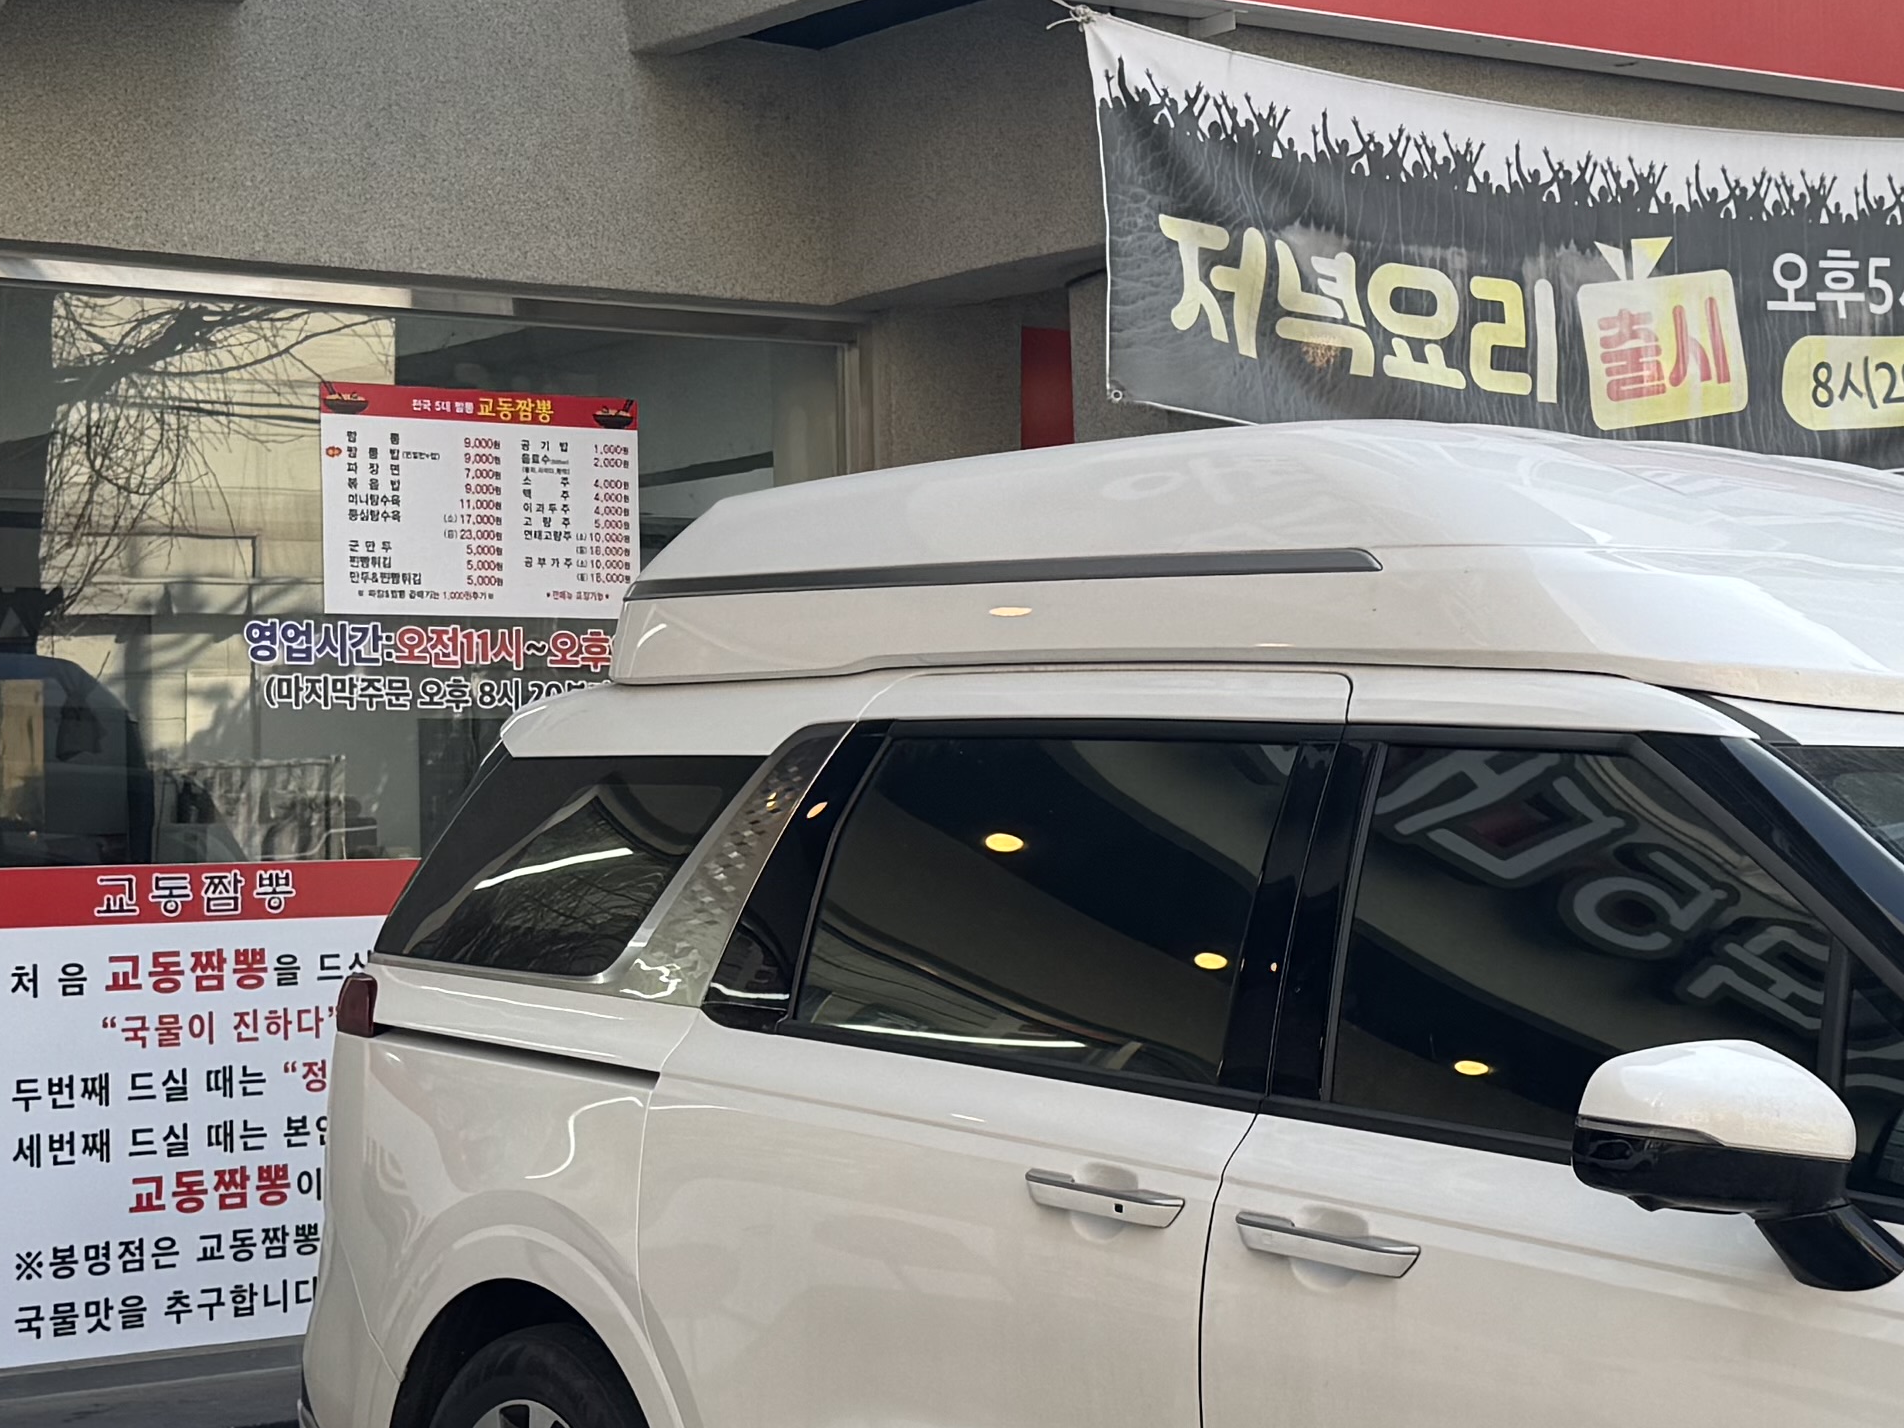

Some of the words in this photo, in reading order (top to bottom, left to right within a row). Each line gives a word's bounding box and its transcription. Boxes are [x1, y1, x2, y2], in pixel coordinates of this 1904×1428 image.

[1160, 213, 1560, 406] 저녁요리
[1598, 294, 1733, 403] 출시
[477, 397, 555, 424] 교동짬뽕
[464, 436, 501, 450] 9,000원
[464, 452, 501, 465] 9,000원
[465, 467, 501, 481] 7,000원
[460, 498, 502, 511] 11,000원
[466, 544, 503, 557] 5,000원
[467, 559, 504, 572] 5,000원
[467, 575, 504, 588] 5,000원
[264, 673, 413, 712] (마지막주문
[416, 677, 473, 713] 오후
[94, 869, 297, 918] 교동짬뽕
[104, 946, 301, 996] 교동짬뽕을
[101, 1010, 215, 1050] “국물이
[11, 1070, 111, 1112] 두번째
[127, 1066, 190, 1102] 드실
[205, 1063, 268, 1099] 때는
[12, 1127, 111, 1170] 세번째
[127, 1121, 191, 1159] 드실
[206, 1118, 269, 1154] 때는
[195, 1222, 321, 1265] 교동짬뽕
[13, 1292, 149, 1341] 국물맛을
